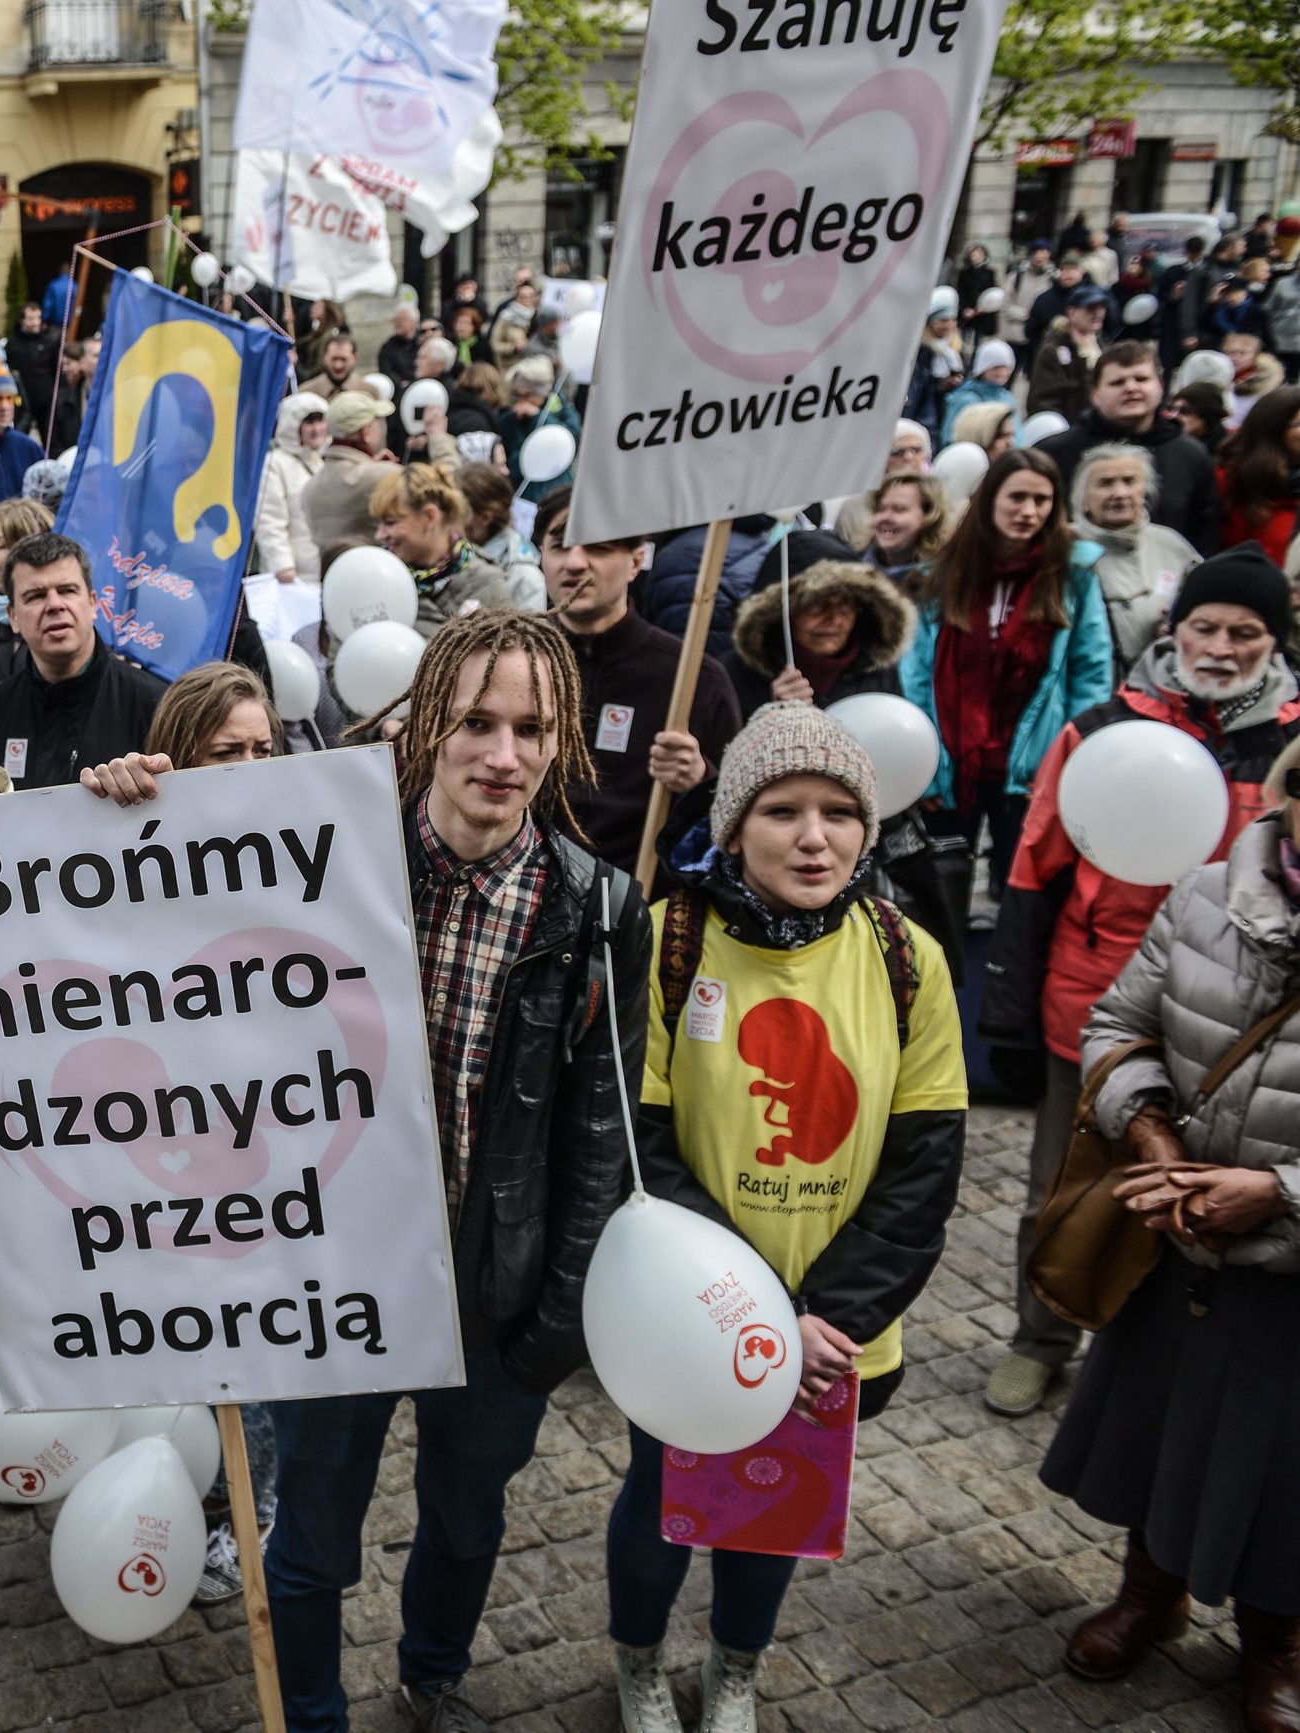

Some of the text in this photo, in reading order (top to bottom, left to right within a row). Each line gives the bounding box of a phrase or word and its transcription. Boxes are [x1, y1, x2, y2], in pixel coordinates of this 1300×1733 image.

[698, 0, 967, 58] Szanuję
[652, 186, 924, 272] każdego
[616, 366, 880, 450] człowieka
[71, 1166, 325, 1271] przed
[737, 1172, 848, 1204] Ratuj mnie!
[51, 1279, 387, 1360] aborcją
[716, 1296, 758, 1333] MARSZ
